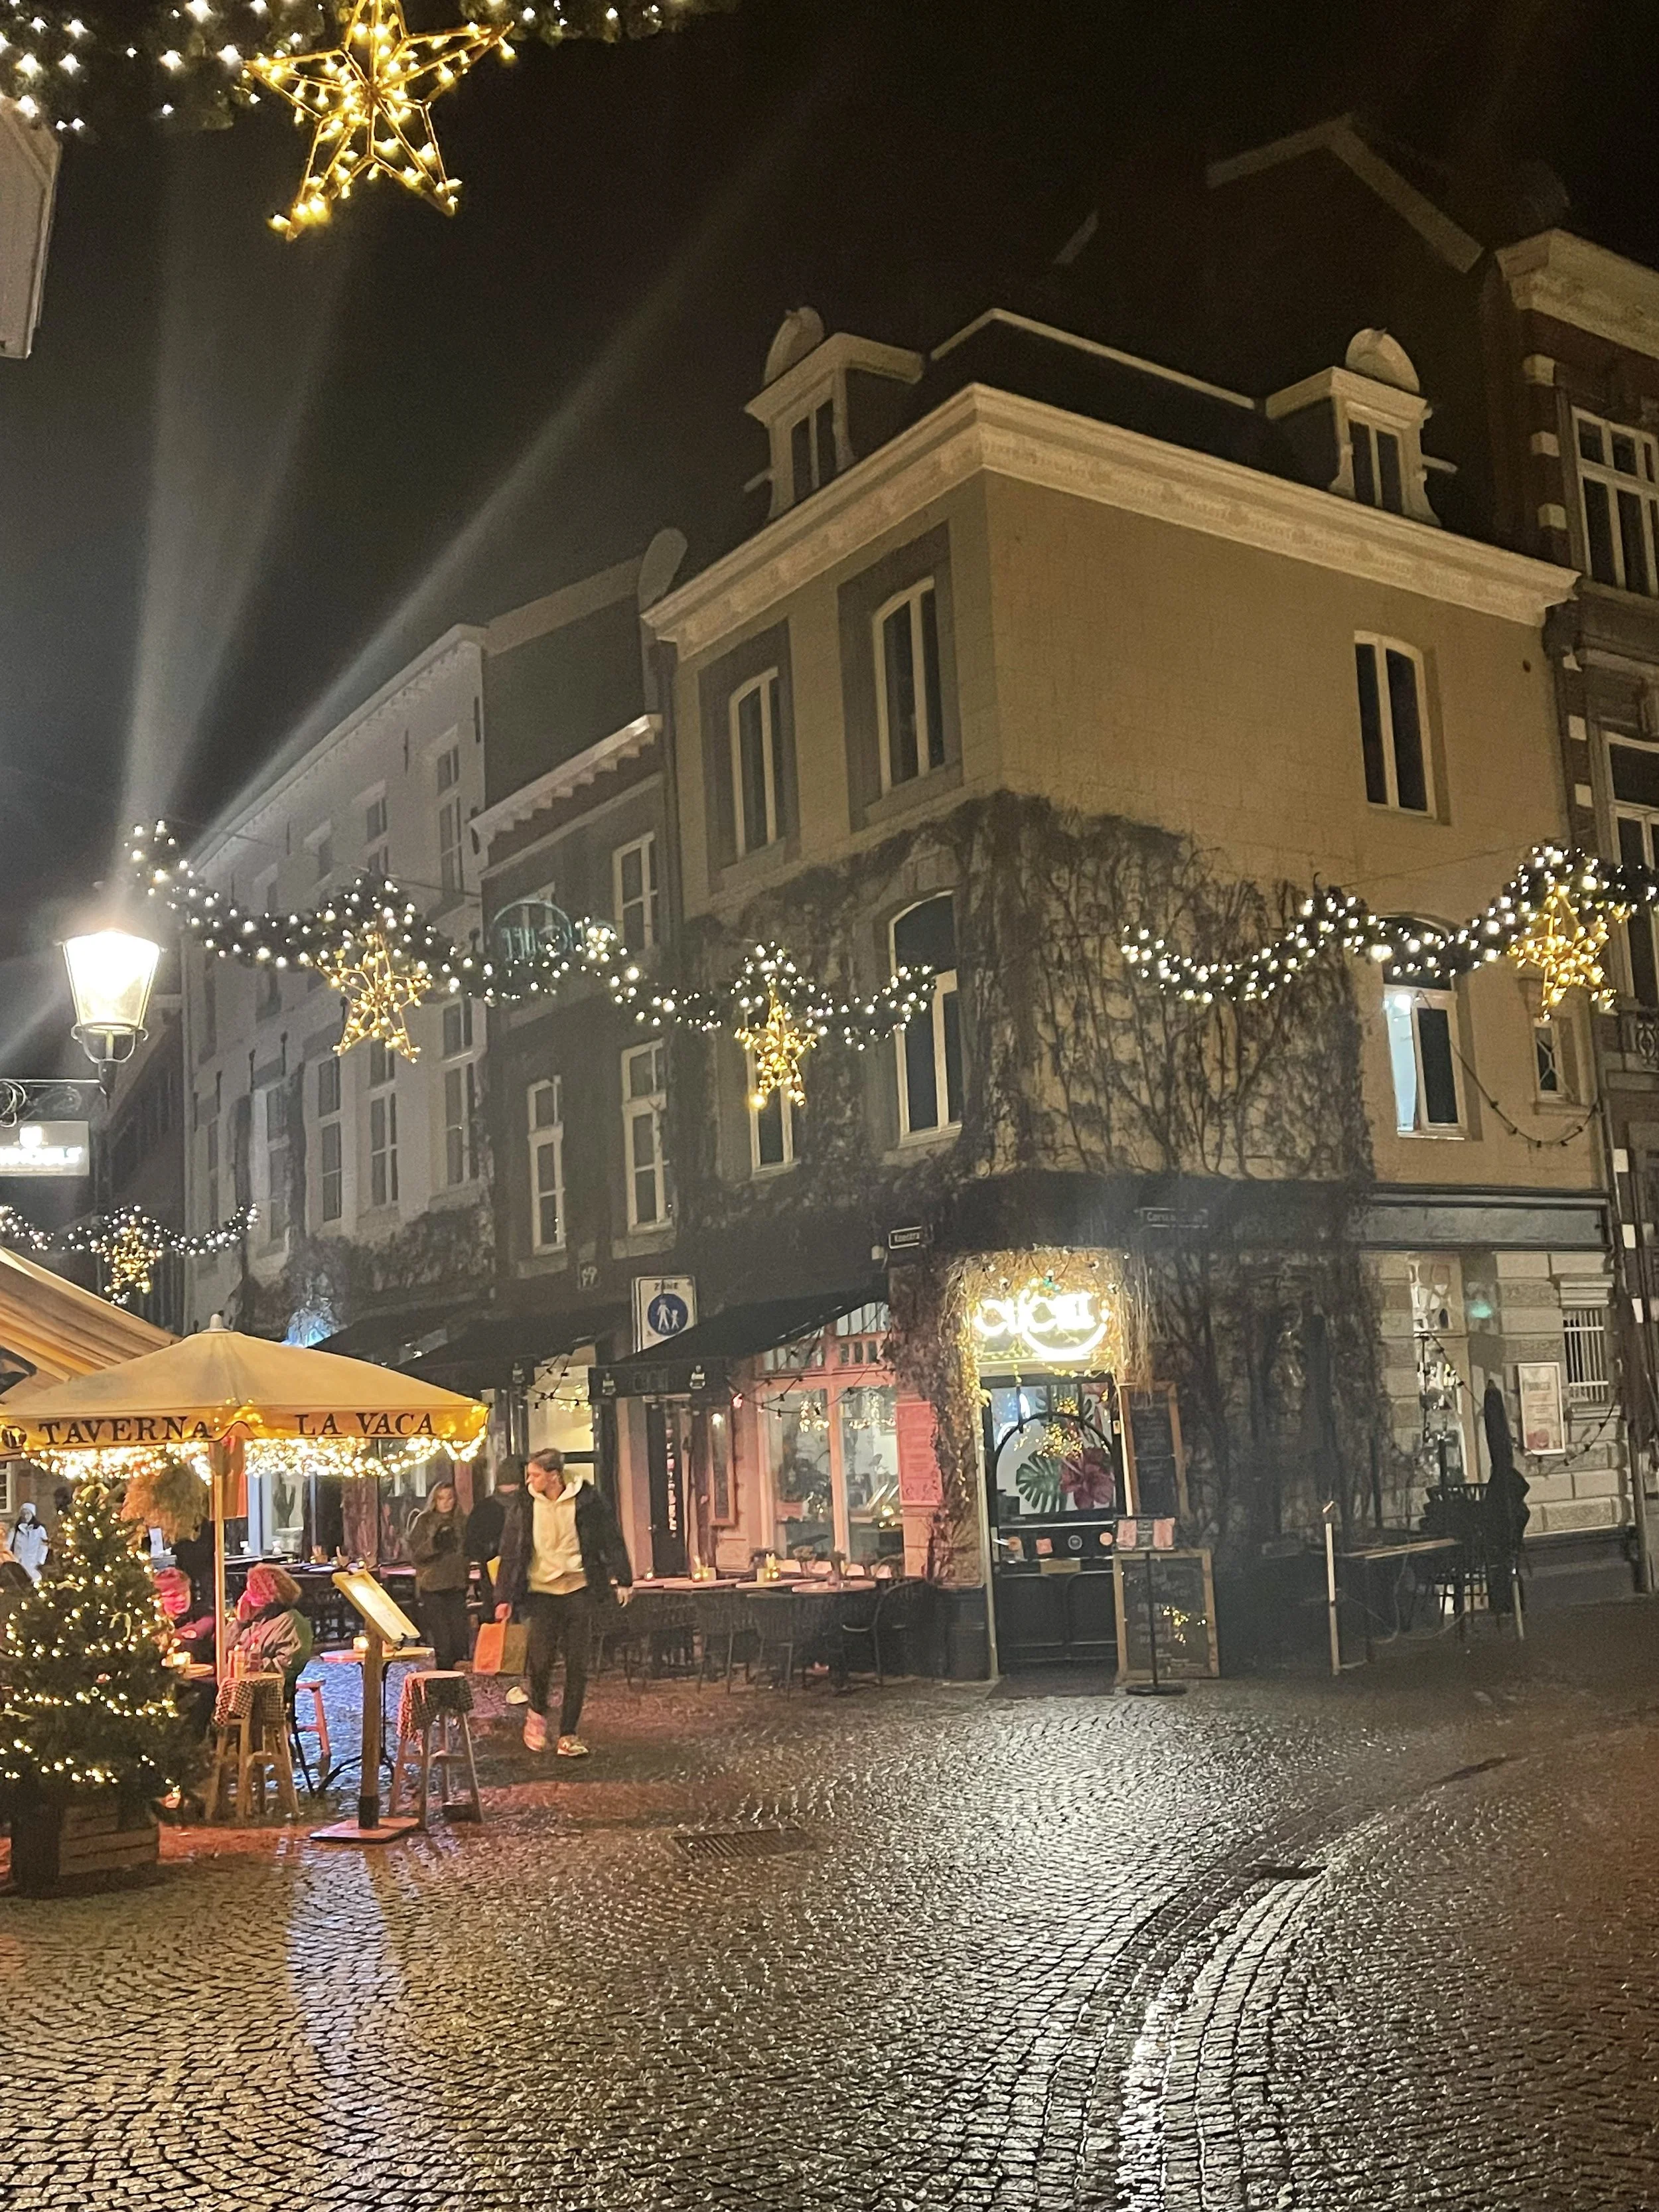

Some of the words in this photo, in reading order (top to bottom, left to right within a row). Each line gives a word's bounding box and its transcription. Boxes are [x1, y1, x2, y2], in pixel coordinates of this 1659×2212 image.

[38, 1416, 213, 1445] TAVERNA
[294, 1413, 342, 1436] LA
[356, 1412, 437, 1436] VACA
